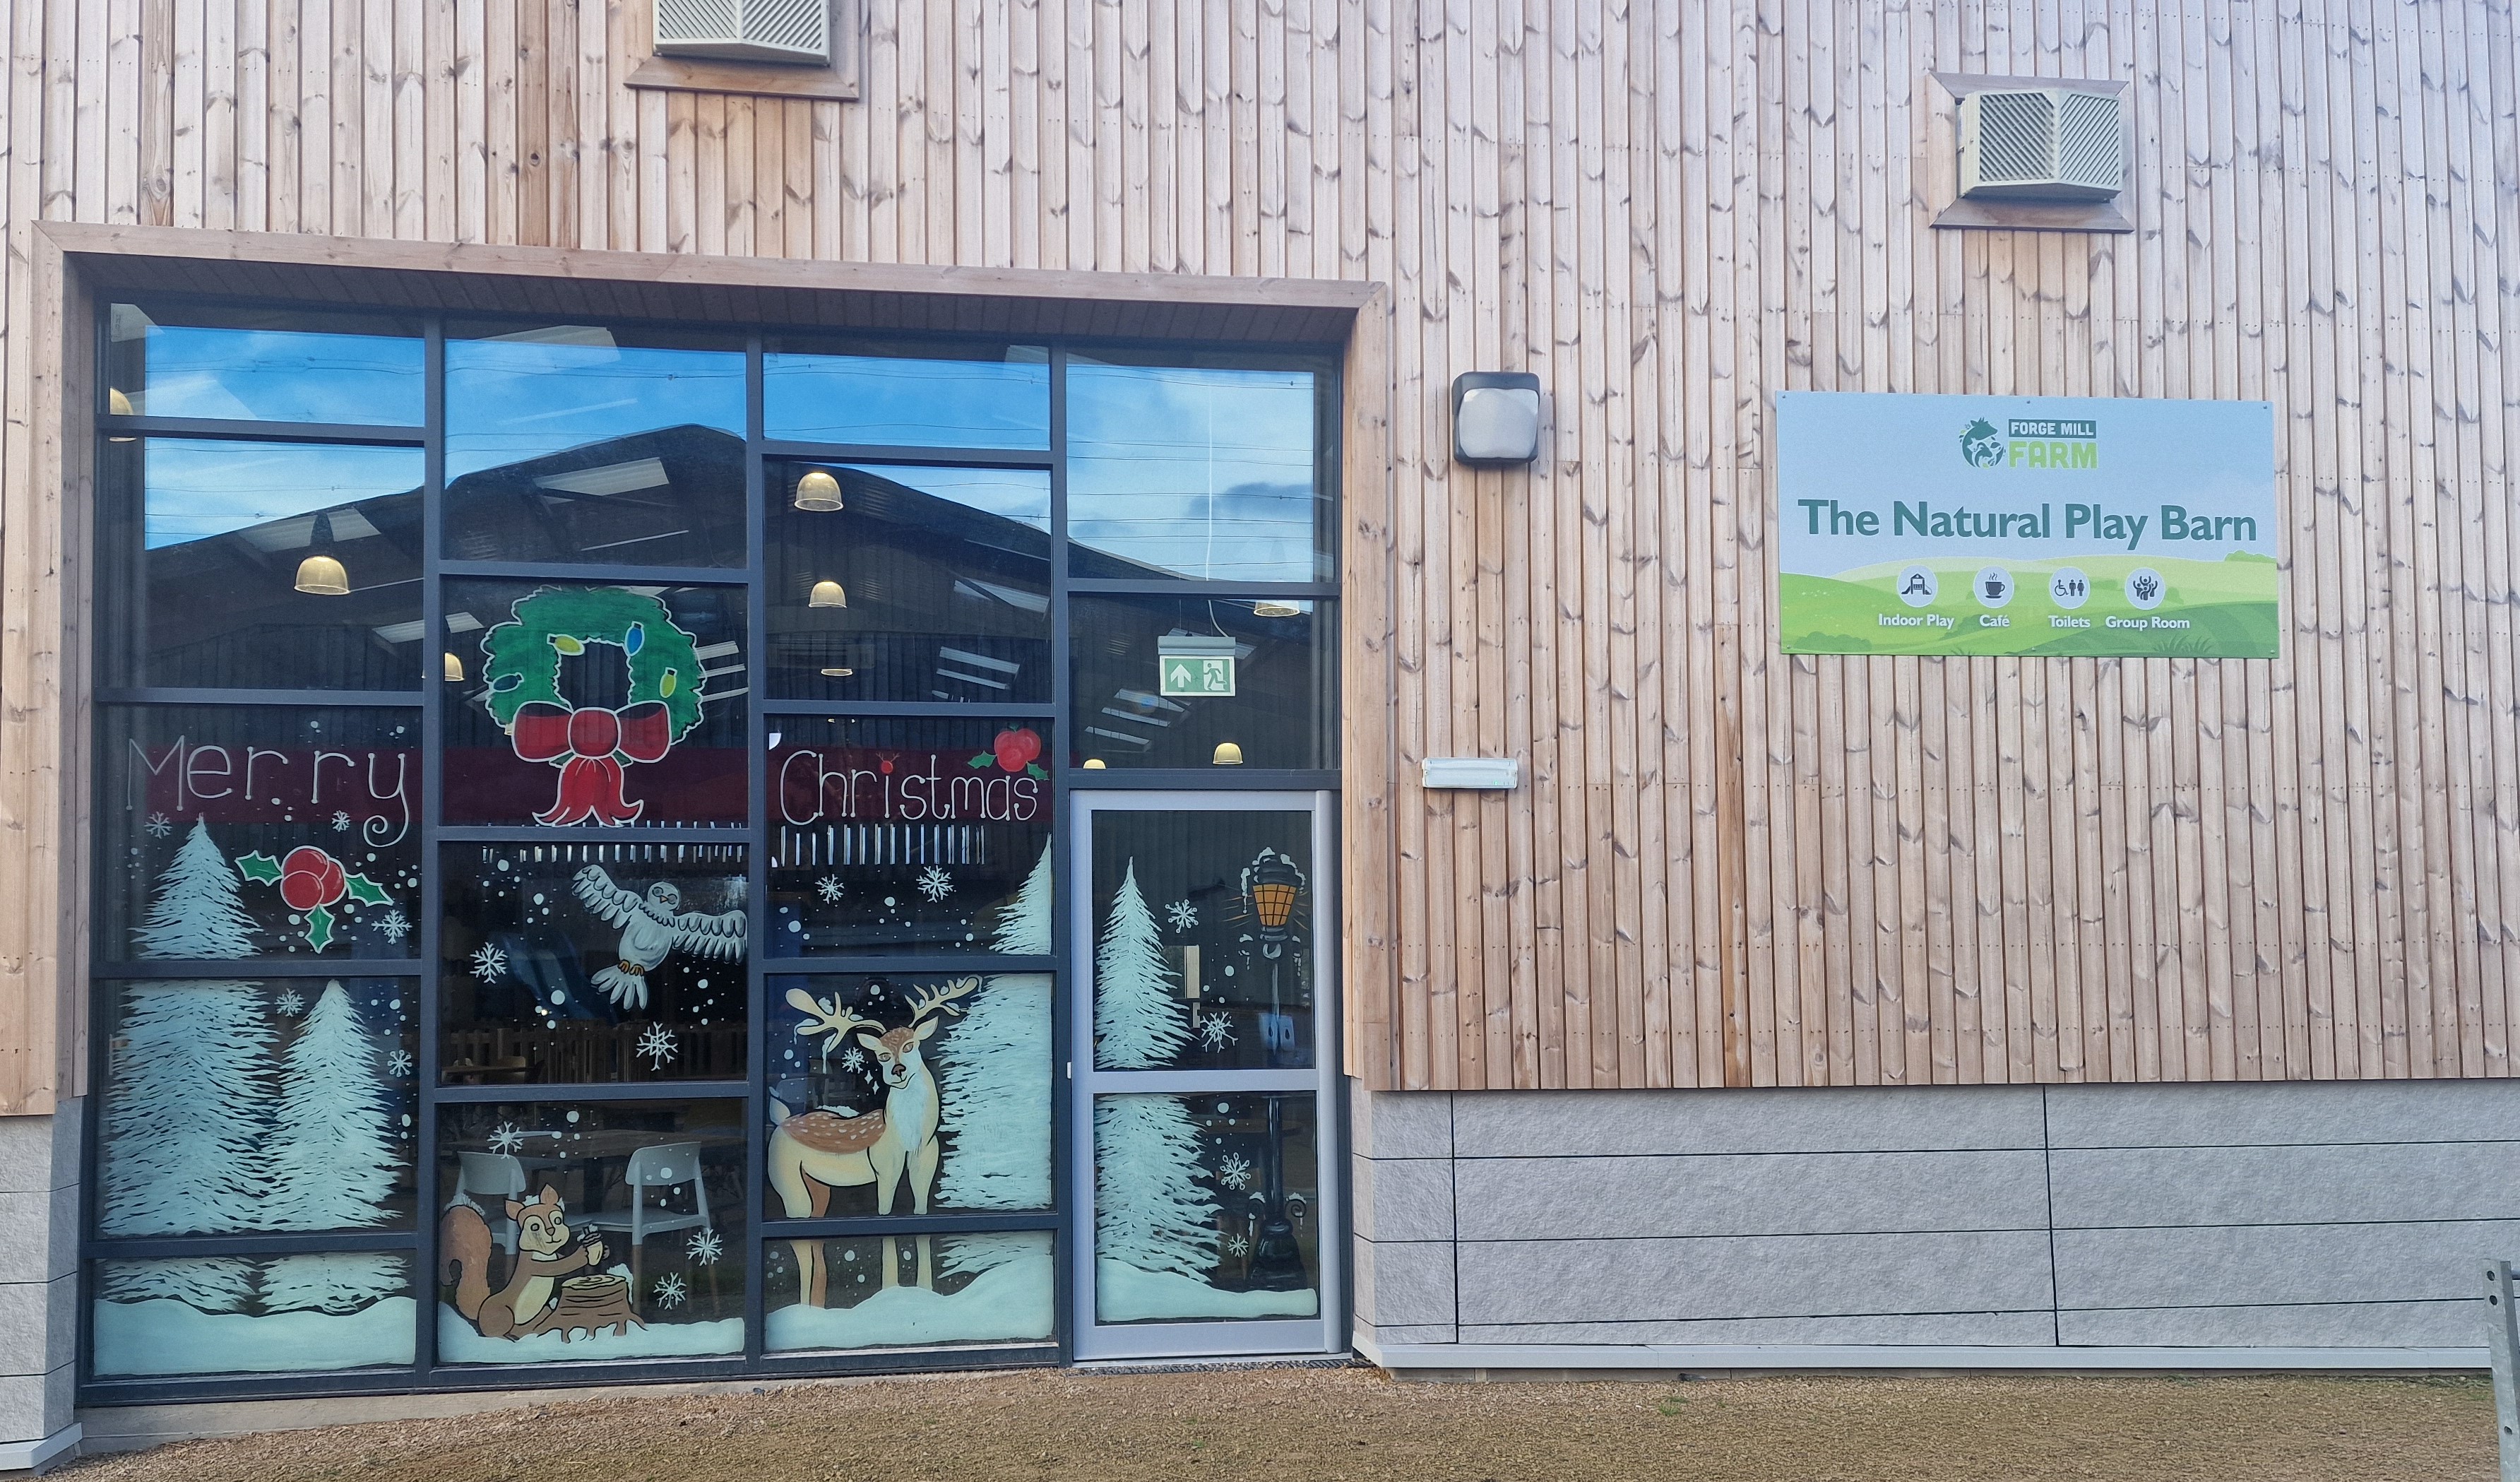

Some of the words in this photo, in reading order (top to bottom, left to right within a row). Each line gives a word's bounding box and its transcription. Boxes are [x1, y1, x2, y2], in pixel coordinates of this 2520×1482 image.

[2011, 422, 2057, 435] FORGE
[2060, 422, 2094, 436] MILL
[2009, 440, 2098, 469] FARM
[1797, 499, 1880, 536] The
[1893, 500, 2050, 538] Natural
[2065, 503, 2148, 551] Play
[2161, 504, 2257, 541] Barn
[1878, 614, 1923, 627] Indoor
[1926, 614, 1955, 630] Play
[1979, 614, 2010, 627] Café
[2048, 615, 2091, 628] Toilets
[2105, 615, 2148, 632] Group
[2151, 616, 2190, 629] Room
[126, 735, 410, 847] Merry
[780, 749, 1039, 826] Christmas
